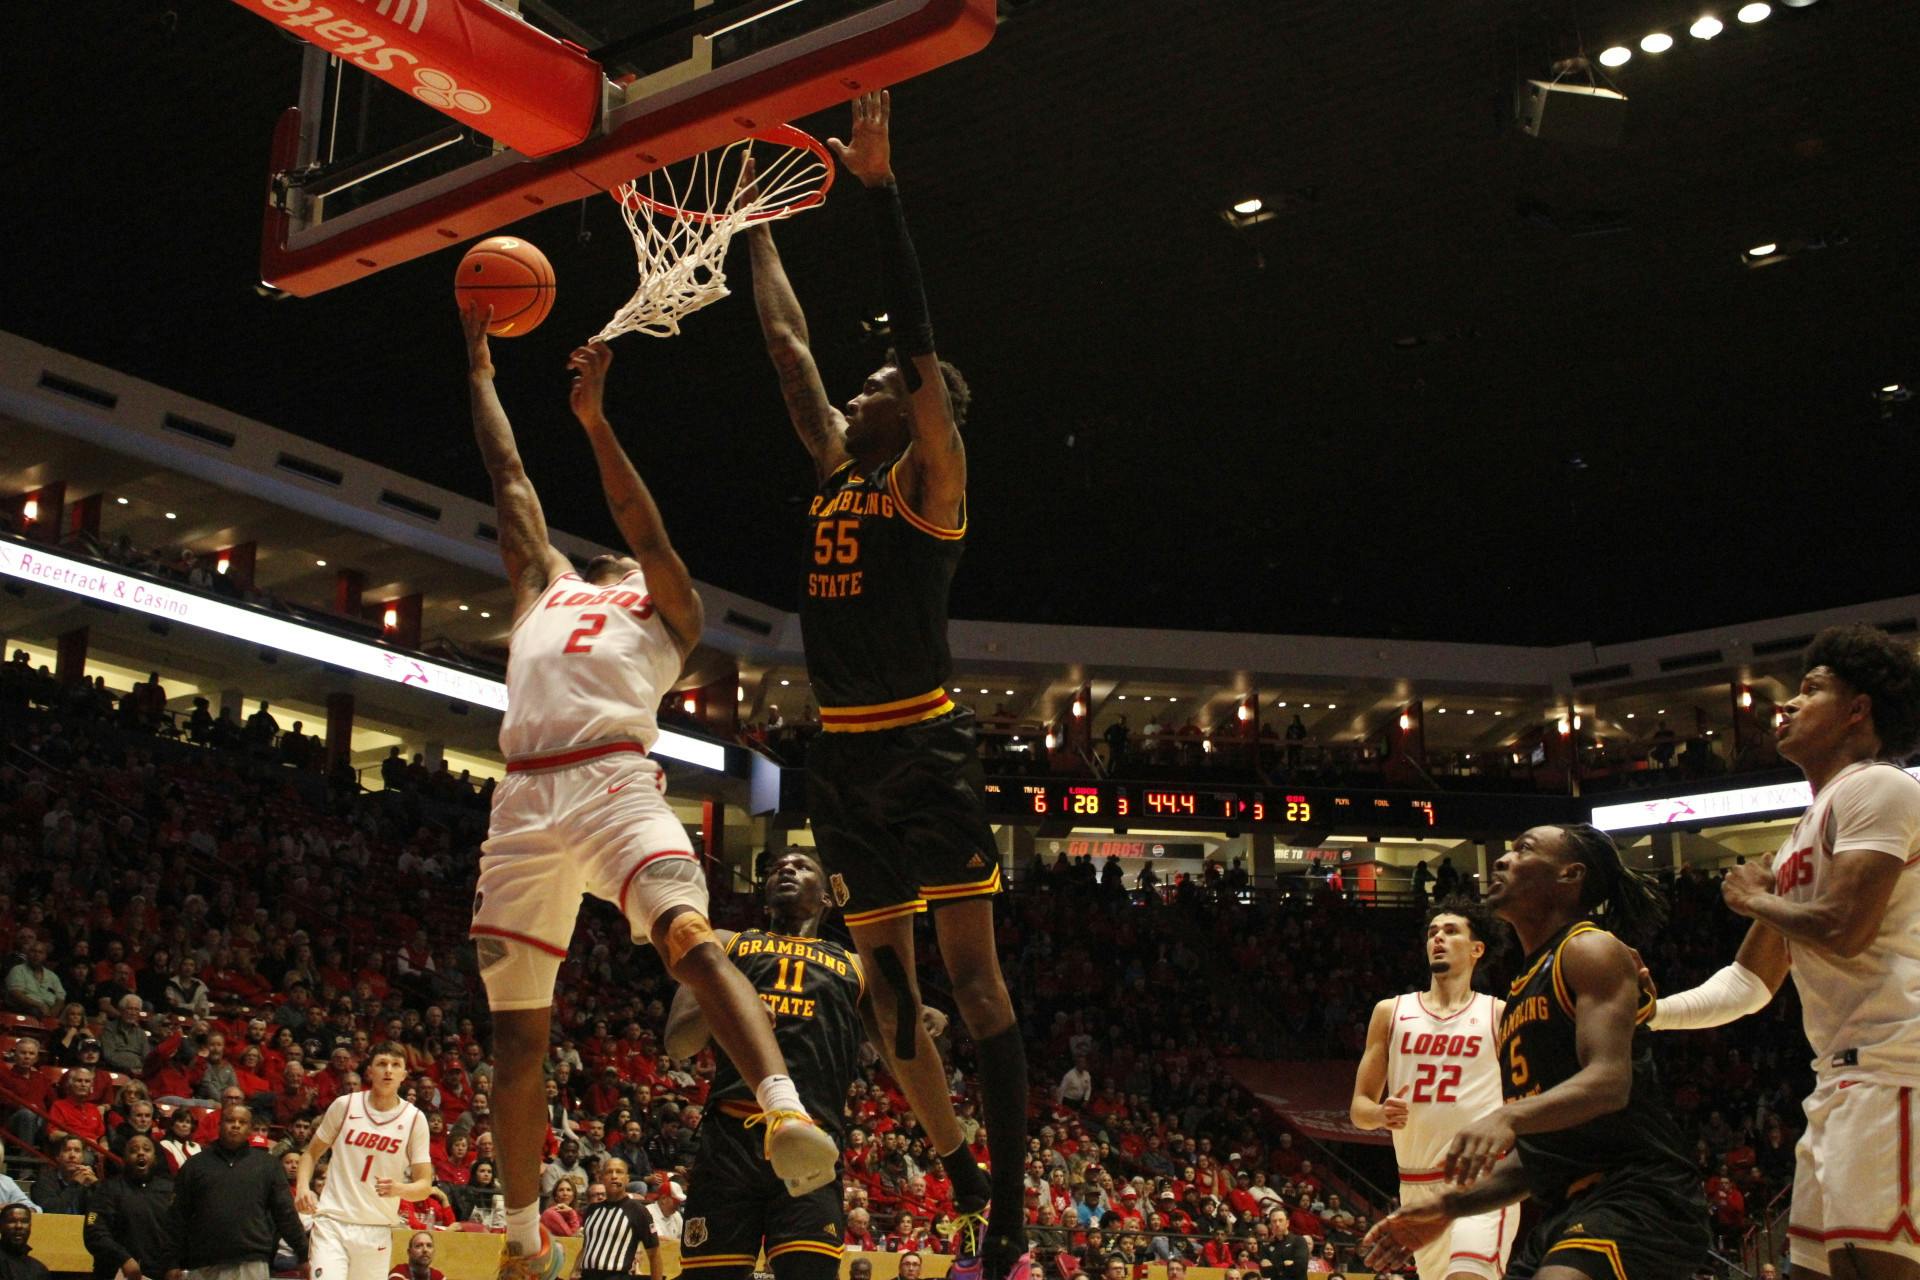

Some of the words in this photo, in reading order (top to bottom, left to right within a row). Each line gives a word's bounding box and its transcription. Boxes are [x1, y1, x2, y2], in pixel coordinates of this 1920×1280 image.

[814, 520, 860, 565] 55
[19, 553, 108, 594] Racetrack
[113, 580, 126, 599] &
[133, 586, 188, 616] Casino
[808, 571, 863, 598] STATE
[544, 590, 655, 620] LOBOS
[562, 613, 607, 654] 2
[984, 785, 1001, 793] FOUL
[1034, 795, 1047, 813] 6
[1073, 795, 1099, 814] 28
[1118, 798, 1128, 815] 3
[1148, 794, 1195, 814] 44.4
[1225, 800, 1231, 817] 1
[1253, 803, 1264, 820] 3
[1286, 803, 1311, 822] 23
[1423, 808, 1434, 825] 7
[1070, 841, 1089, 857] GO
[1291, 849, 1303, 860] TO
[738, 940, 848, 977] GRAMBLING
[774, 957, 806, 993] 11
[1400, 1031, 1483, 1058] LOBOS
[1510, 1035, 1529, 1086] 5
[1412, 1064, 1463, 1103] 22
[344, 1129, 403, 1154] LOBOS
[360, 1155, 375, 1183] 1
